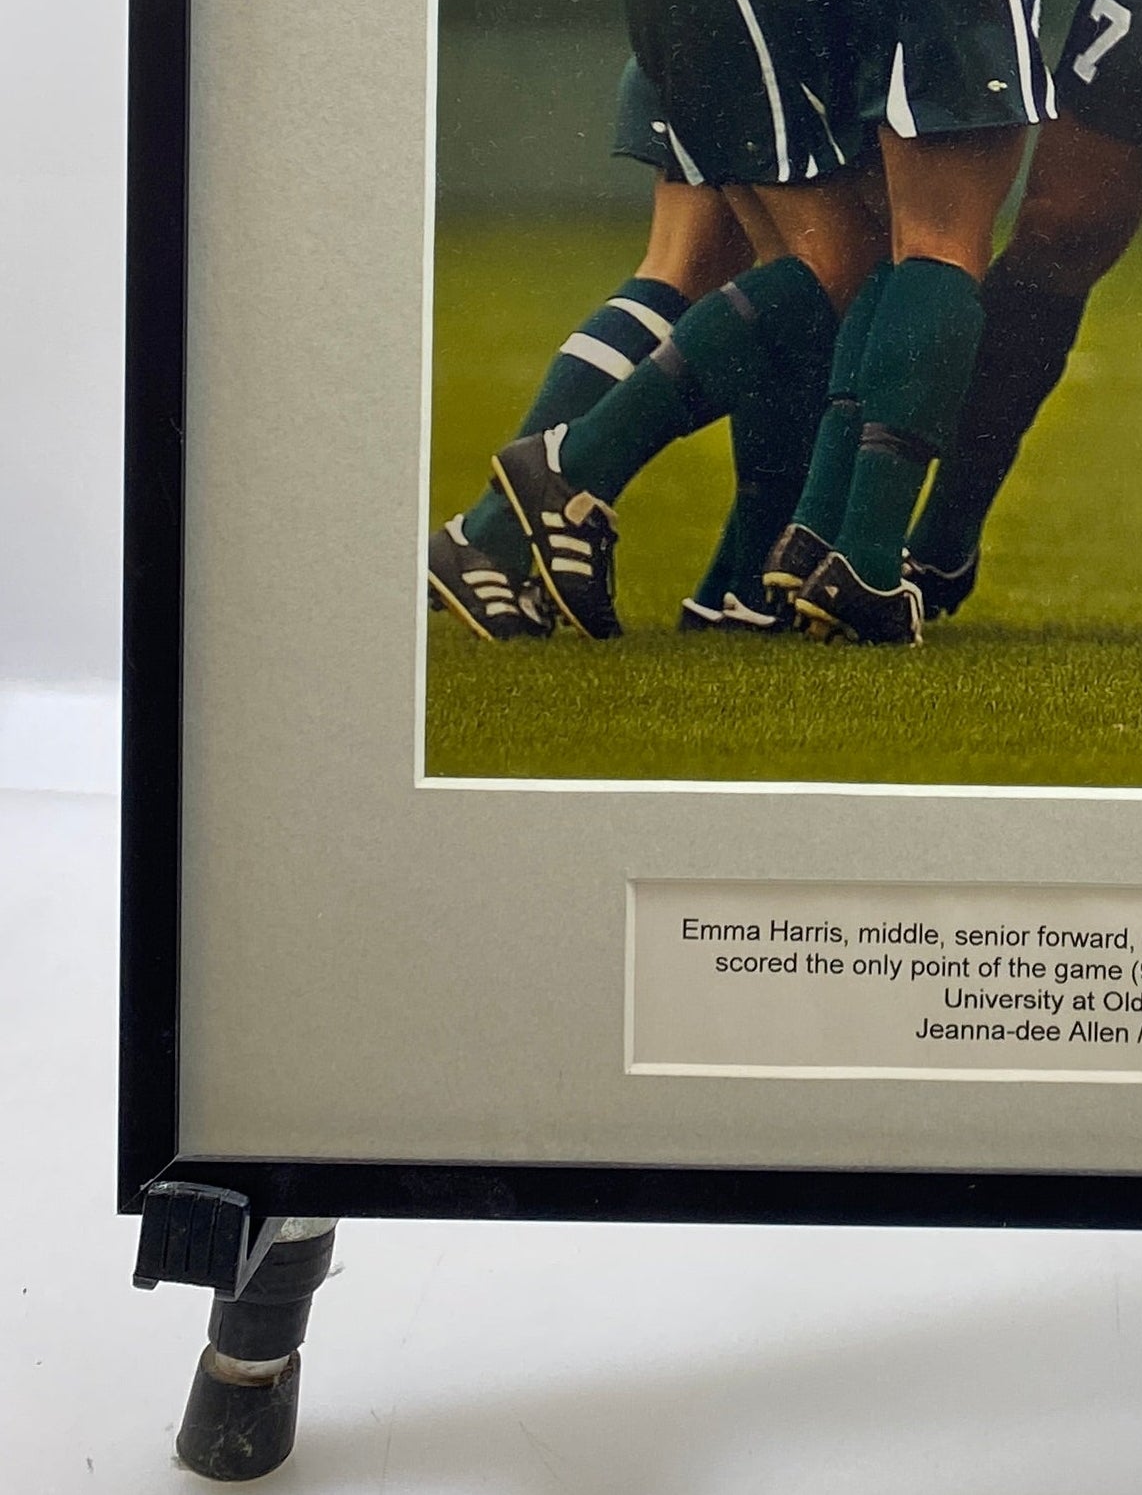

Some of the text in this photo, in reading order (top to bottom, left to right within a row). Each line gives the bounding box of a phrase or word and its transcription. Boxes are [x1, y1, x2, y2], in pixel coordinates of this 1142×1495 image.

[682, 917, 761, 942] Emma
[769, 919, 849, 948] Harris,
[858, 921, 945, 950] middle,
[954, 924, 1031, 947] senior
[1036, 924, 1135, 954] forward,
[715, 951, 798, 974] scored
[805, 952, 845, 975] the
[852, 953, 903, 982] only
[910, 955, 971, 982] point
[978, 956, 1003, 979] of
[1007, 956, 1047, 979] the
[1054, 962, 1123, 985] game
[944, 987, 1065, 1016] University
[1072, 990, 1096, 1012] at
[915, 1017, 1061, 1042] Jeanna-dee
[1068, 1020, 1129, 1044] Allen
